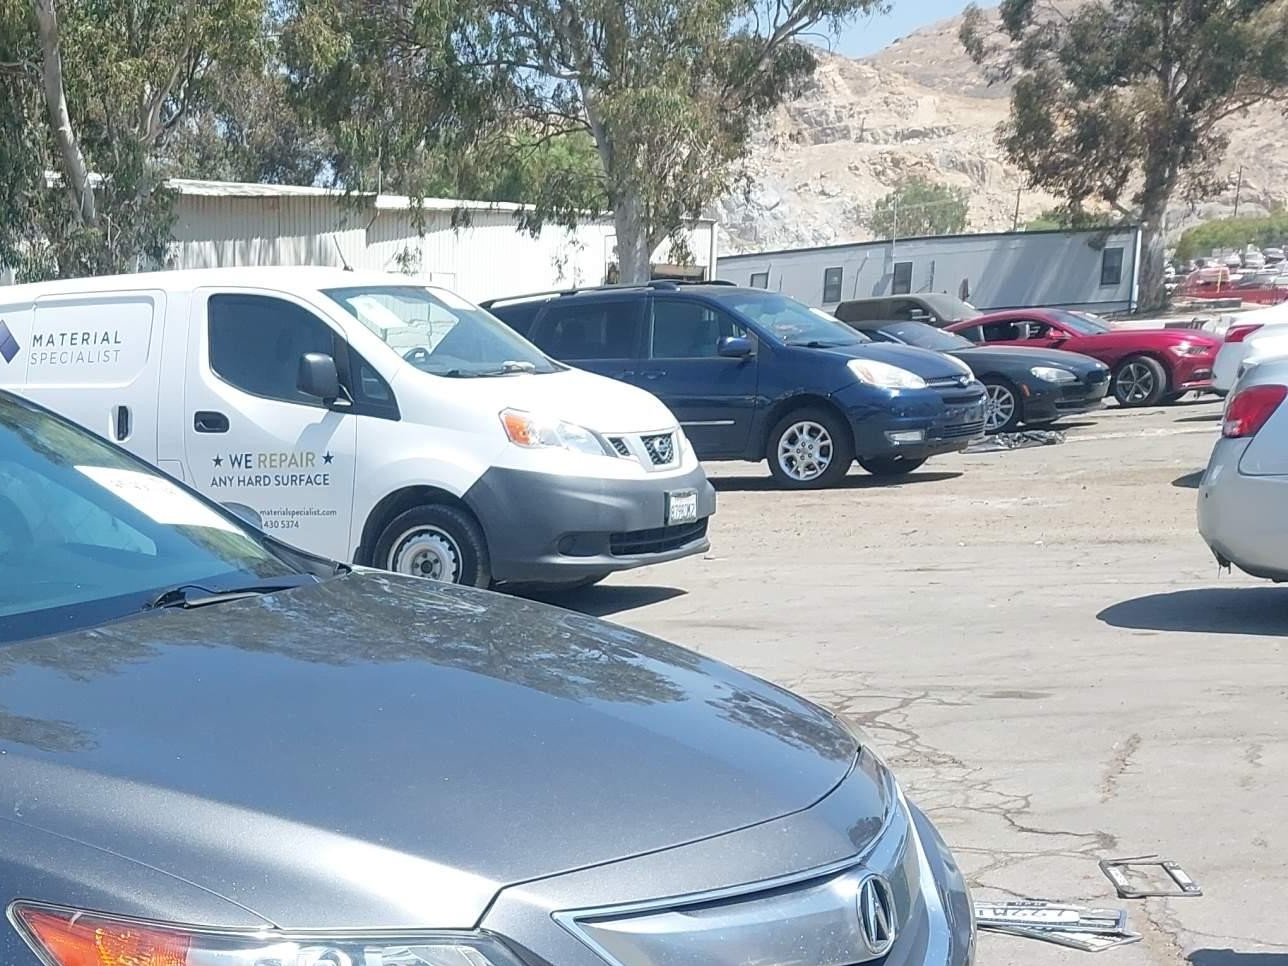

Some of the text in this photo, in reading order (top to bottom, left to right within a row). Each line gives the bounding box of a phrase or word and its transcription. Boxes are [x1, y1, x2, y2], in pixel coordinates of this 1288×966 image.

[32, 330, 122, 347] MATERIAL
[30, 349, 121, 365] SPECIALIST
[229, 452, 316, 469] WE REPAIR
[210, 473, 330, 488] ANY HARD SURFACE
[263, 520, 300, 529] 430 5374
